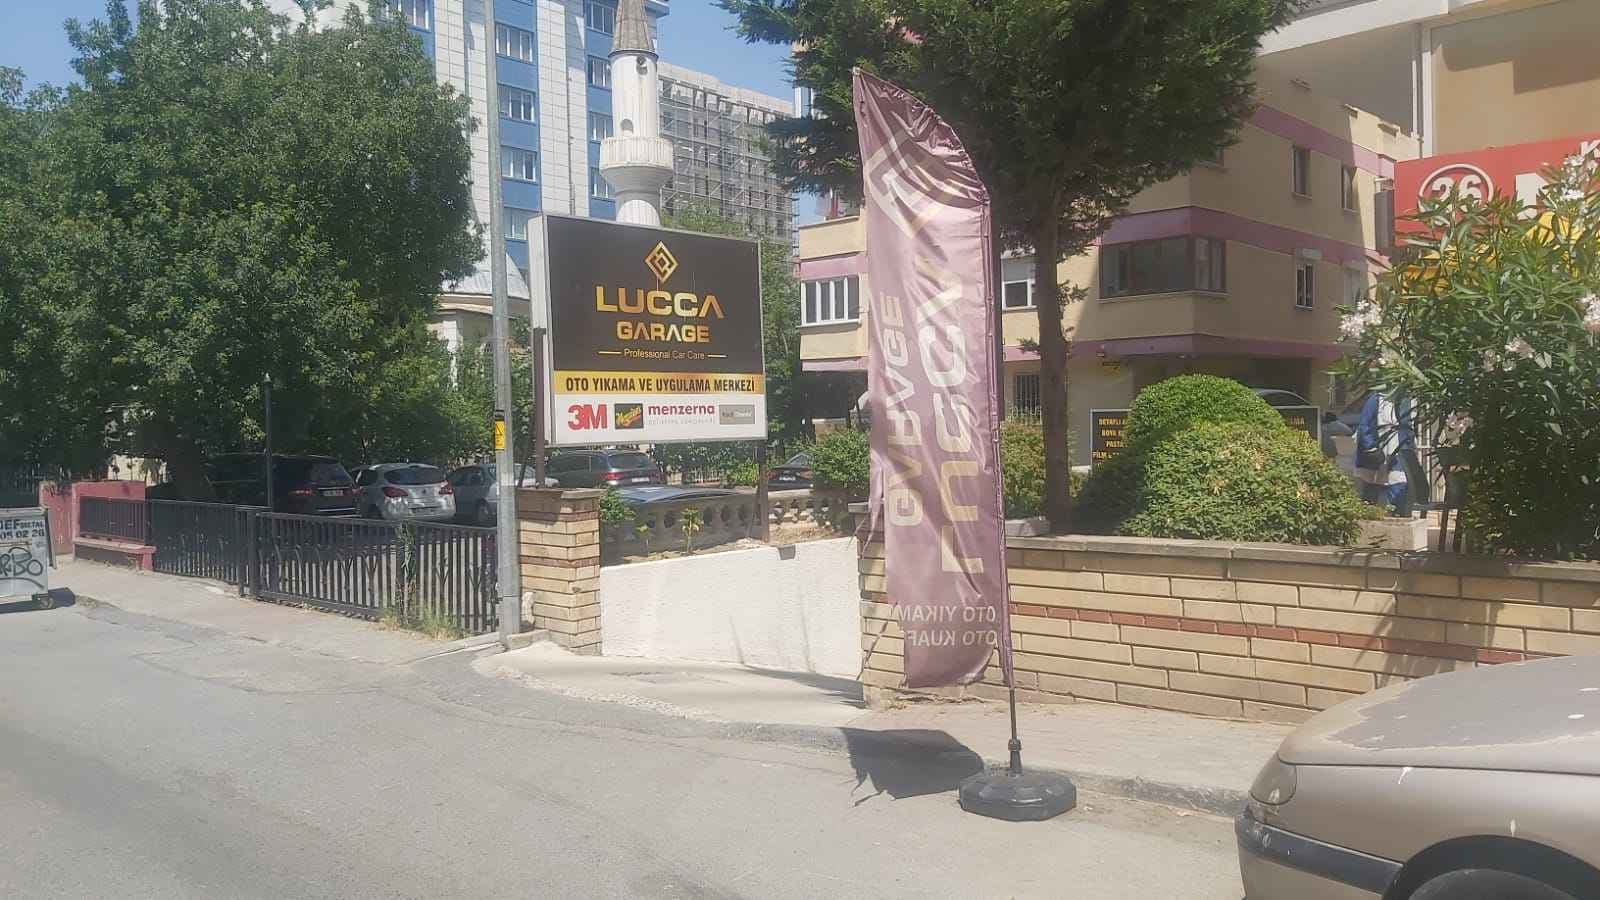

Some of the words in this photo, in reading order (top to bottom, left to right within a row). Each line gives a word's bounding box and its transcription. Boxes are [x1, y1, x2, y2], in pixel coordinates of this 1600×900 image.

[1431, 174, 1482, 212] 26
[595, 286, 724, 319] LUCCA
[616, 320, 710, 343] GARAGE
[624, 348, 670, 359] Professional
[672, 350, 686, 360] Car
[687, 350, 705, 360] Care
[566, 377, 589, 392] OTO
[592, 377, 636, 392] YIKAMA
[637, 378, 652, 392] VE
[655, 378, 711, 392] UYGULAMA
[714, 376, 755, 392] MERKEZİ
[568, 404, 608, 431] 3M
[648, 405, 715, 416] menzerna
